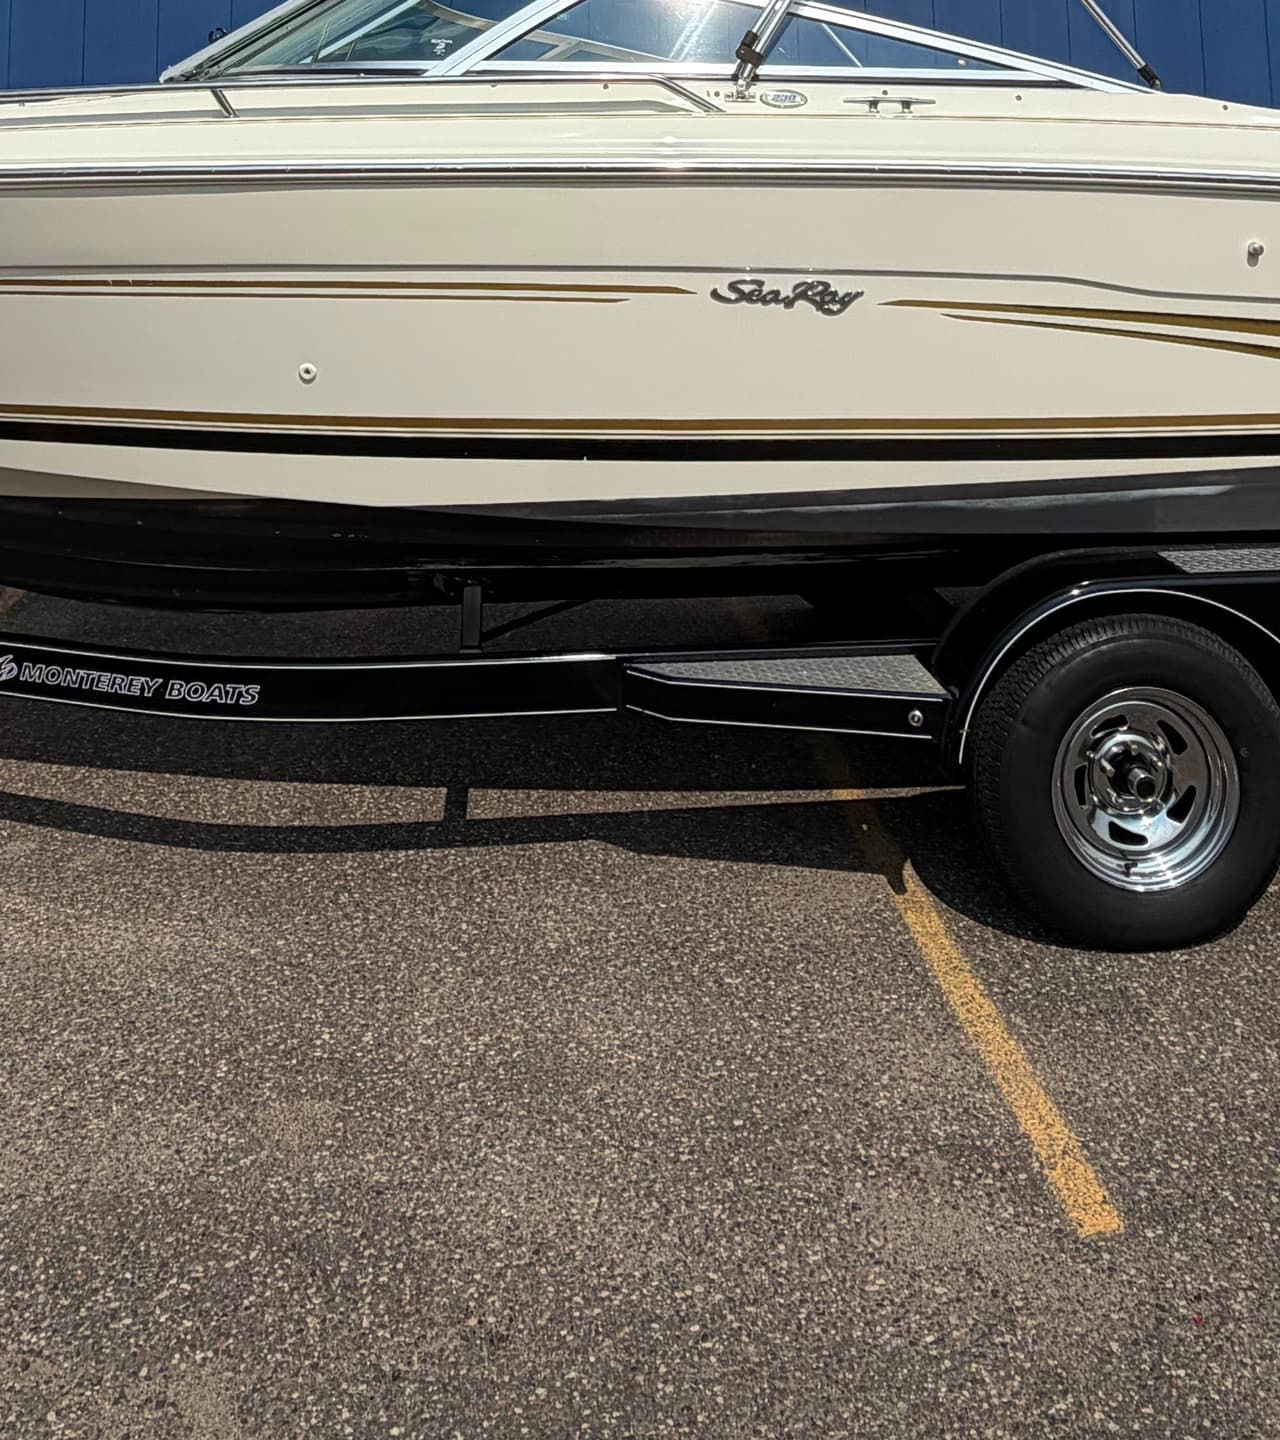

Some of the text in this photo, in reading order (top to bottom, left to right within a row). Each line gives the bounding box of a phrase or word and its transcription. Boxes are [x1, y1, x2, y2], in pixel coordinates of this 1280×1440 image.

[709, 278, 865, 317] Sea Ray
[20, 662, 261, 706] MONTEREY BOATS
